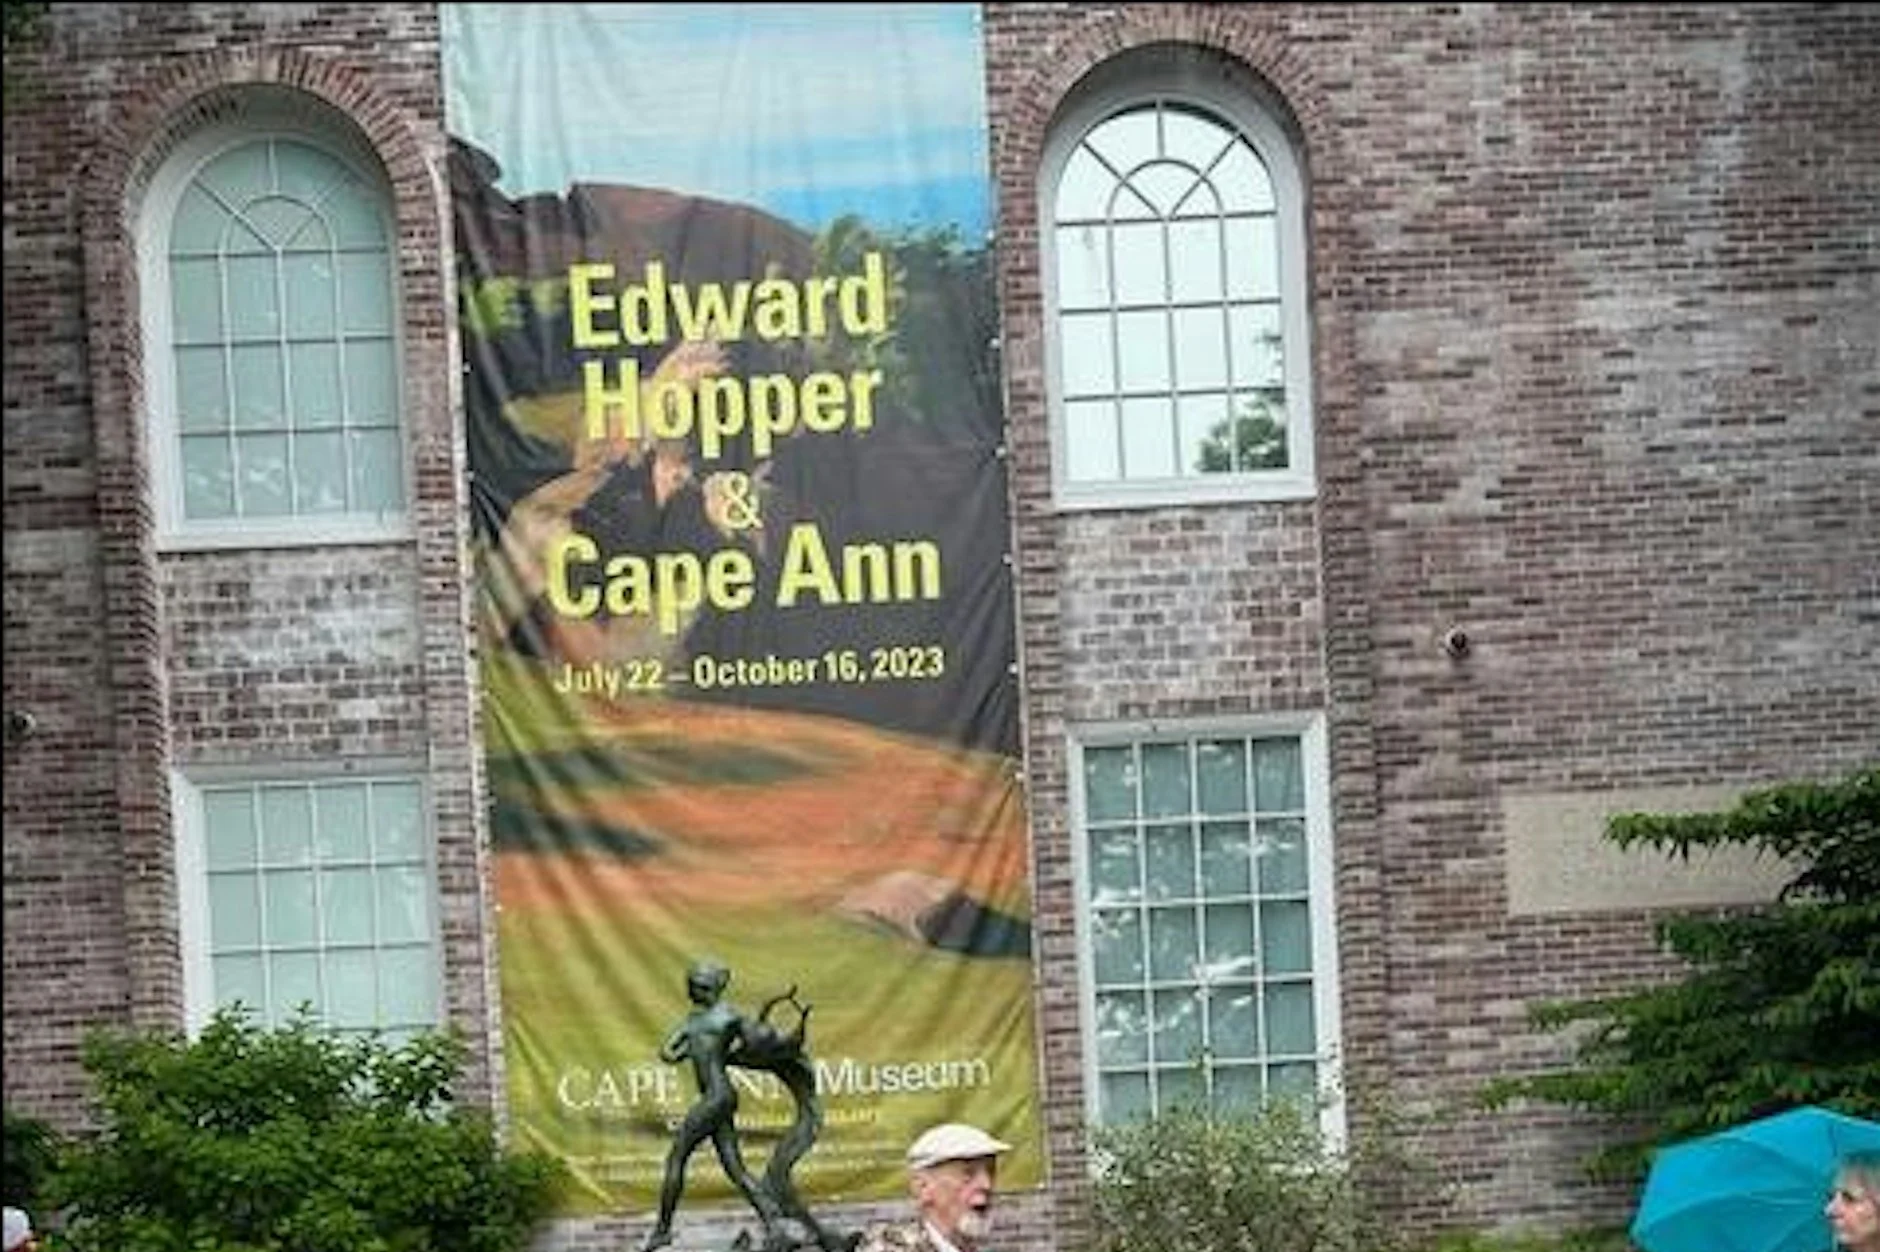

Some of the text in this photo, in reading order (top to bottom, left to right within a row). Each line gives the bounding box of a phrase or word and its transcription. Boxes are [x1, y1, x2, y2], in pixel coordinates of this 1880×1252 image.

[568, 252, 888, 348] Edward
[582, 358, 881, 459] Hopper
[704, 470, 763, 529] &
[547, 522, 941, 634] Cape Ann
[553, 661, 621, 701] July
[625, 658, 665, 689] 22
[693, 654, 819, 689] October
[823, 650, 867, 684] 16,
[870, 646, 945, 680] 2023
[557, 1063, 682, 1109] CAPE
[814, 1057, 991, 1096] Museum
